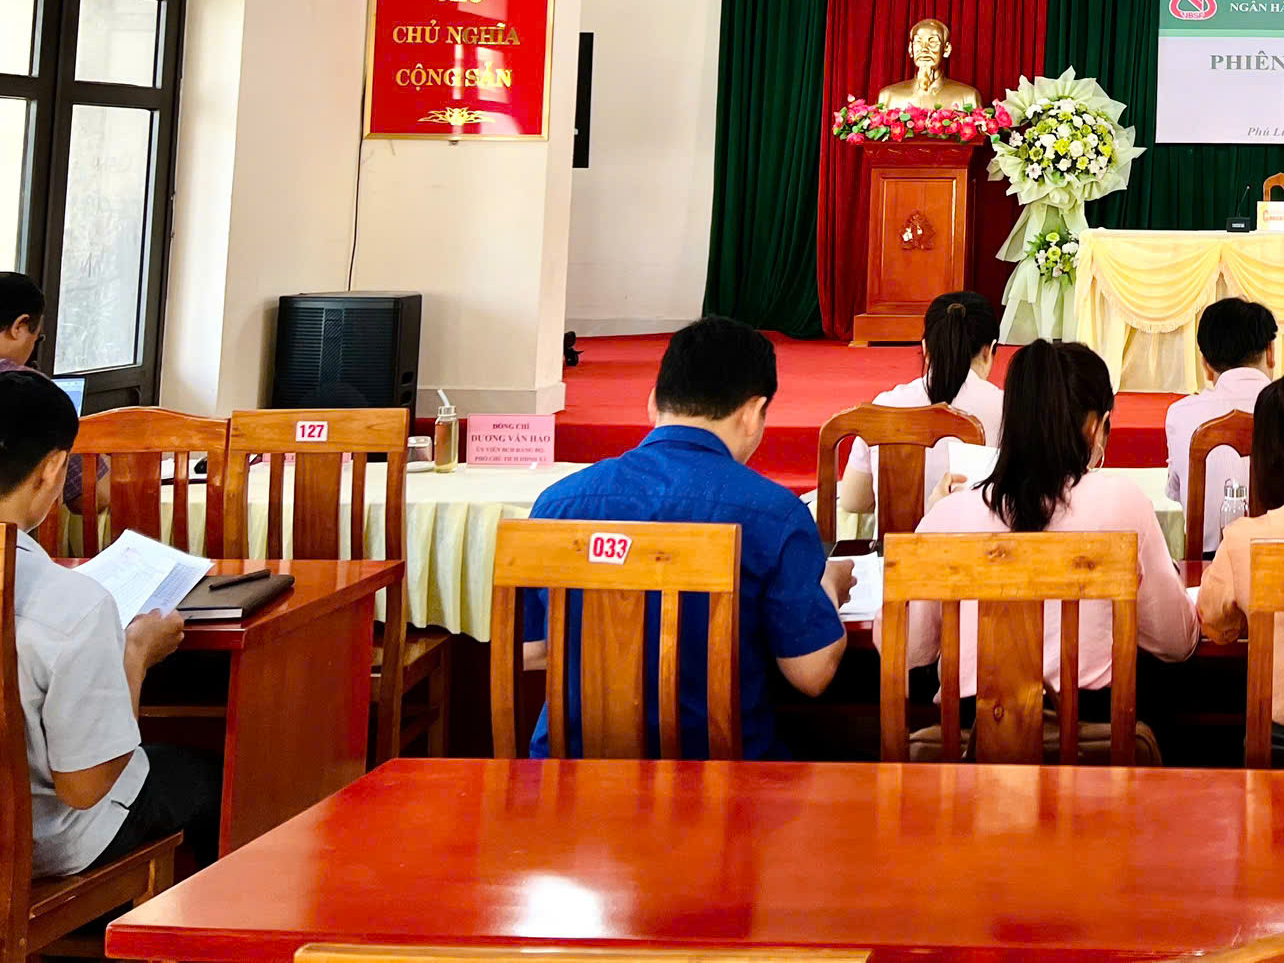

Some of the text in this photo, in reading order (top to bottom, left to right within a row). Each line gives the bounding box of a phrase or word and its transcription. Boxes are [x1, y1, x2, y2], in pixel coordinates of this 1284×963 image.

[1230, 0, 1267, 12] NGÂN
[392, 19, 521, 45] CHỦ NGHĨA
[396, 61, 512, 90] CỘNG SẢN
[299, 424, 325, 438] 127
[593, 537, 628, 559] 033
